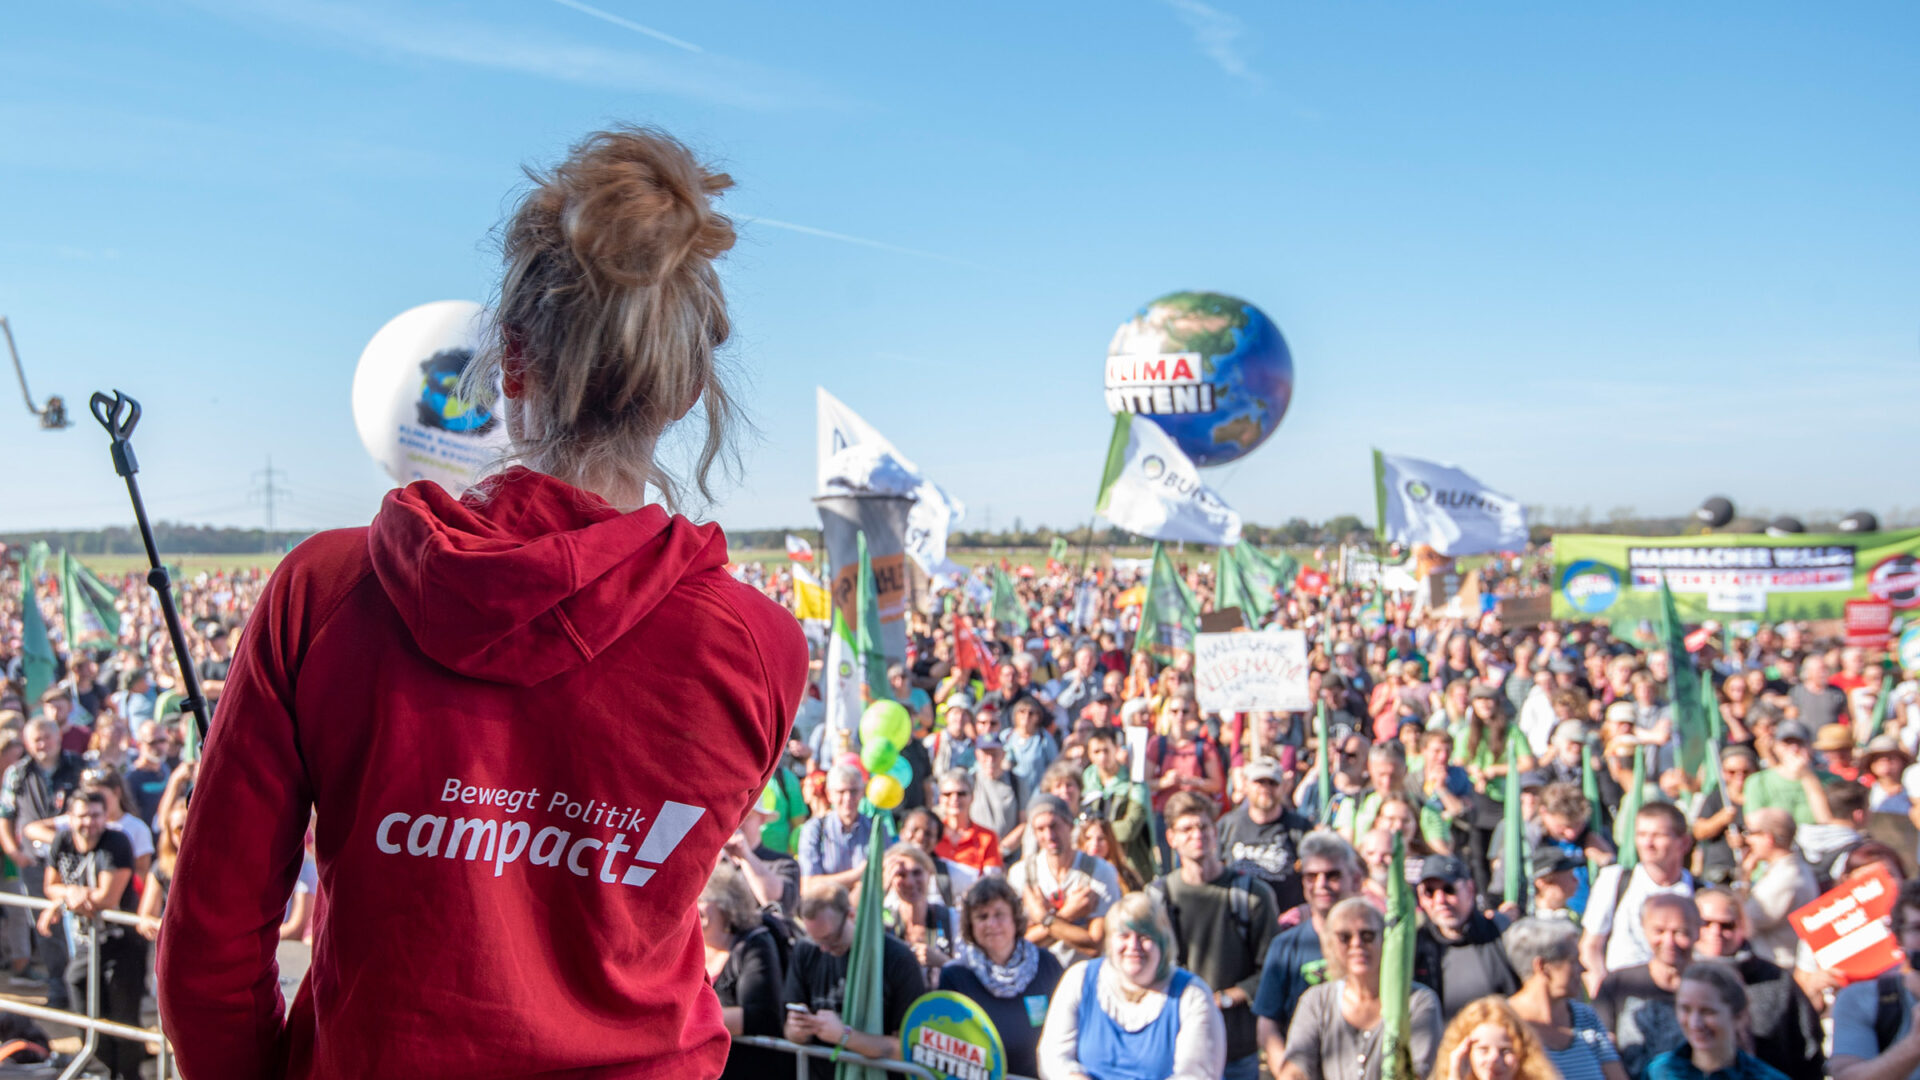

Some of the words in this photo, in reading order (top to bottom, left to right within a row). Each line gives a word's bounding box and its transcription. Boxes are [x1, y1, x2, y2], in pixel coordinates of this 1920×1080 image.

[1110, 358, 1195, 381] LIMA
[440, 778, 540, 813] Bewegt
[547, 791, 646, 832] Politik
[376, 800, 706, 887] campact!
[922, 1029, 982, 1065] KLIMA
